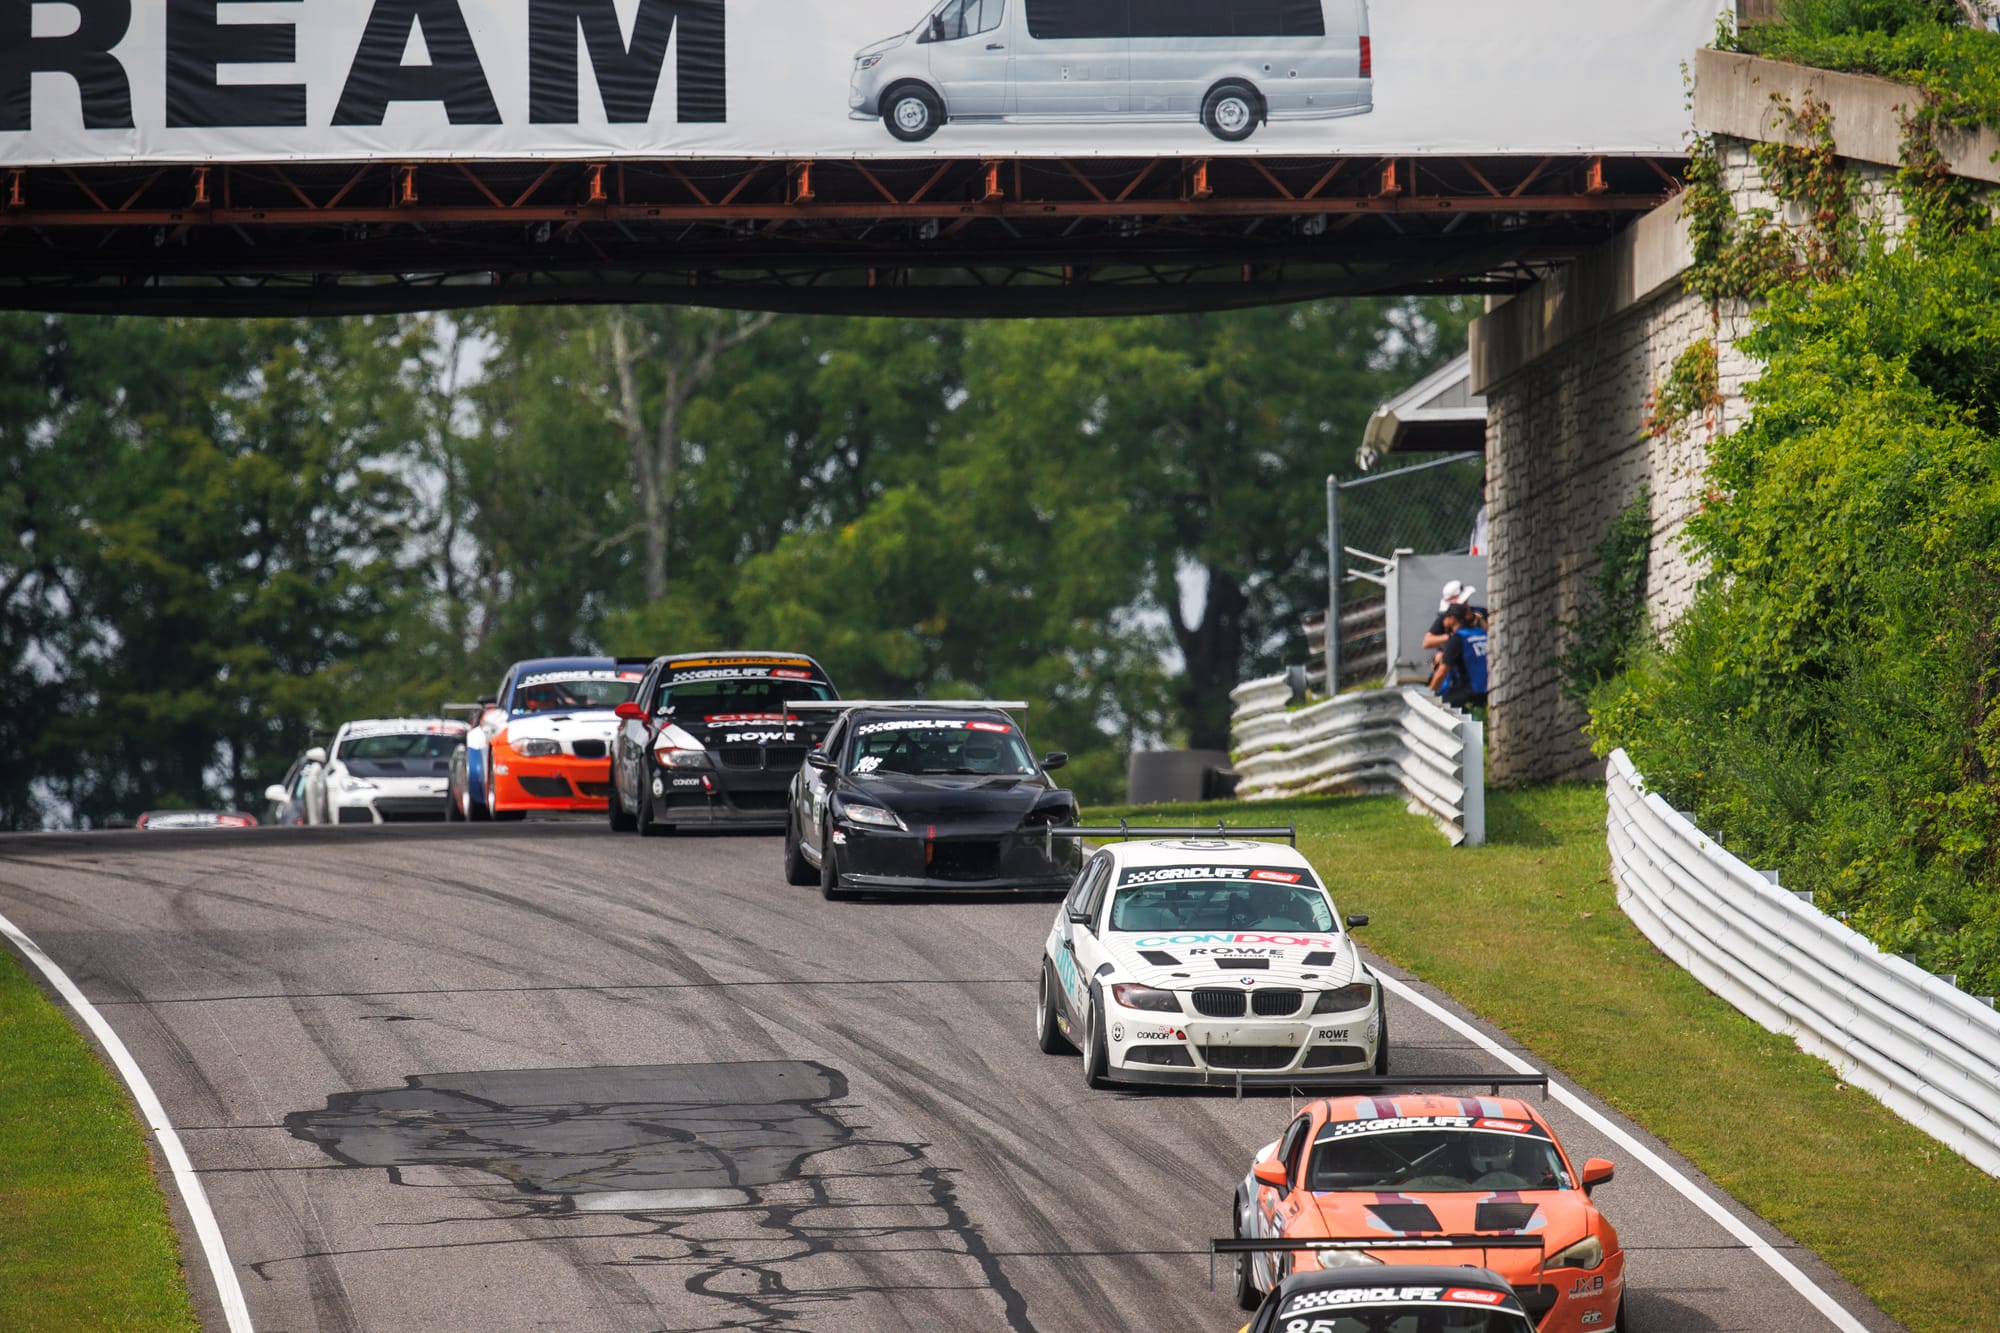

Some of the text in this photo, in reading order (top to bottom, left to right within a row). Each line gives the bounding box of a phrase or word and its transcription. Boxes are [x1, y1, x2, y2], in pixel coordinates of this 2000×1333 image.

[695, 668, 771, 679] GRIDLIFE
[883, 720, 966, 730] GRIDLIFE
[725, 732, 795, 743] ROWE
[852, 755, 883, 773] 105
[1155, 867, 1249, 881] GRIDLIFE
[1135, 934, 1333, 948] CONDOR
[1189, 947, 1286, 956] ROWE
[1136, 1031, 1170, 1040] CONDOR
[1318, 1029, 1349, 1039] ROWE
[1365, 1116, 1474, 1131] GRIDLIFE
[1569, 1275, 1604, 1295] JXB
[1326, 1287, 1444, 1304] GRIDLIFE
